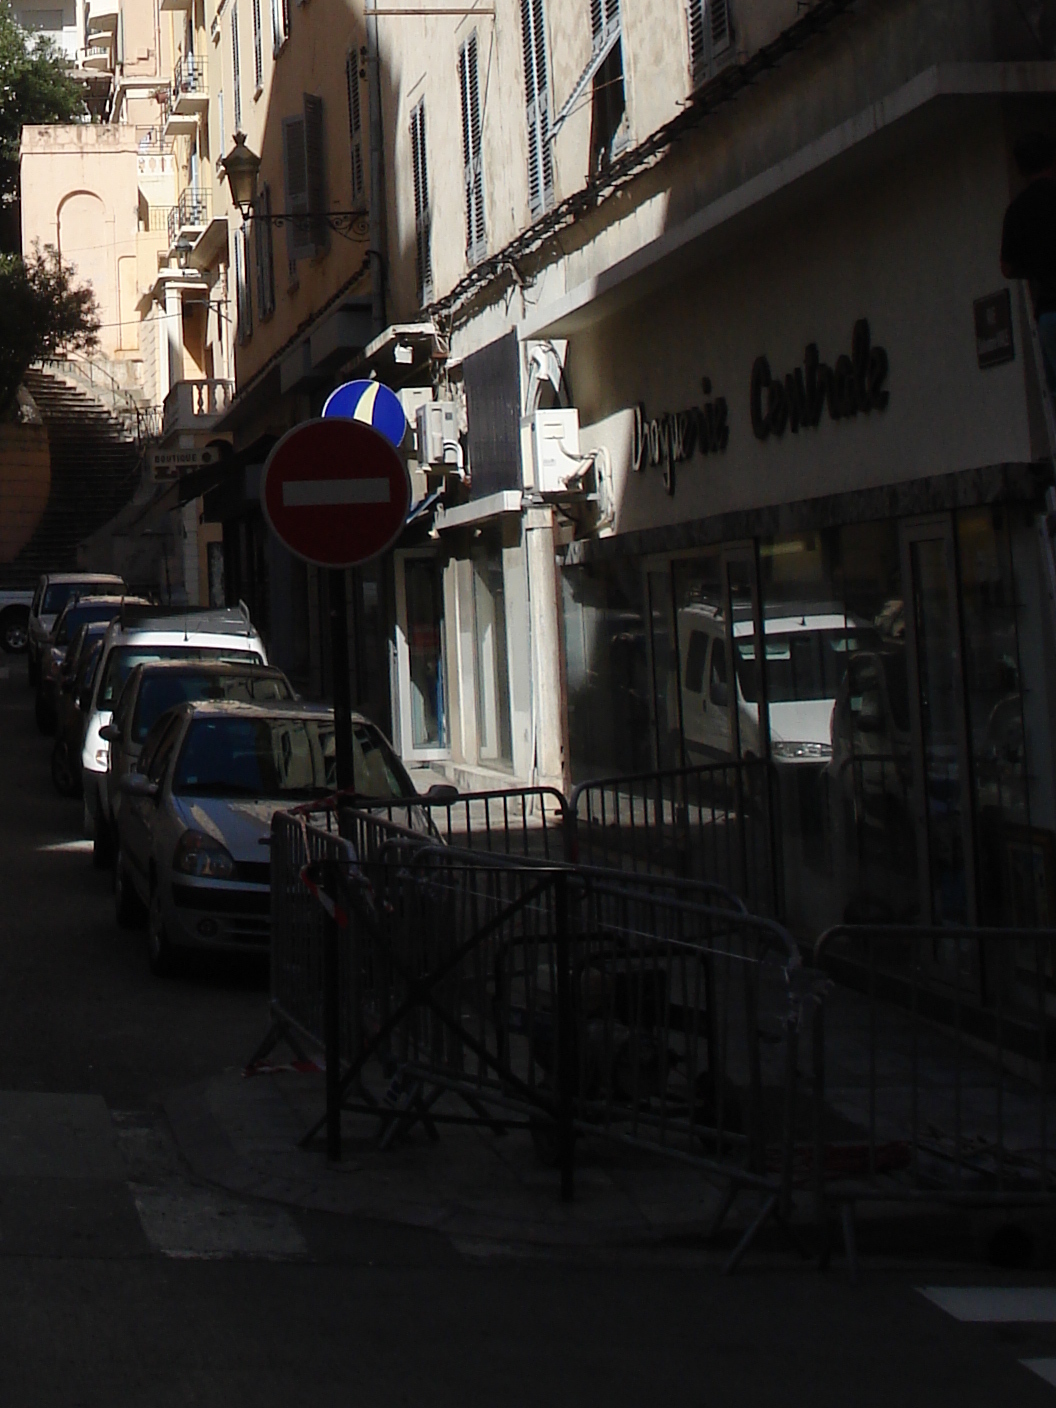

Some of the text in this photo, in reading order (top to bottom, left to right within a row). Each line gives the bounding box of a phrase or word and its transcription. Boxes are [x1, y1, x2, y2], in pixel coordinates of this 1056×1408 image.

[632, 317, 890, 496] Droguerie Centrale
[154, 453, 197, 464] BOUTIQUE
